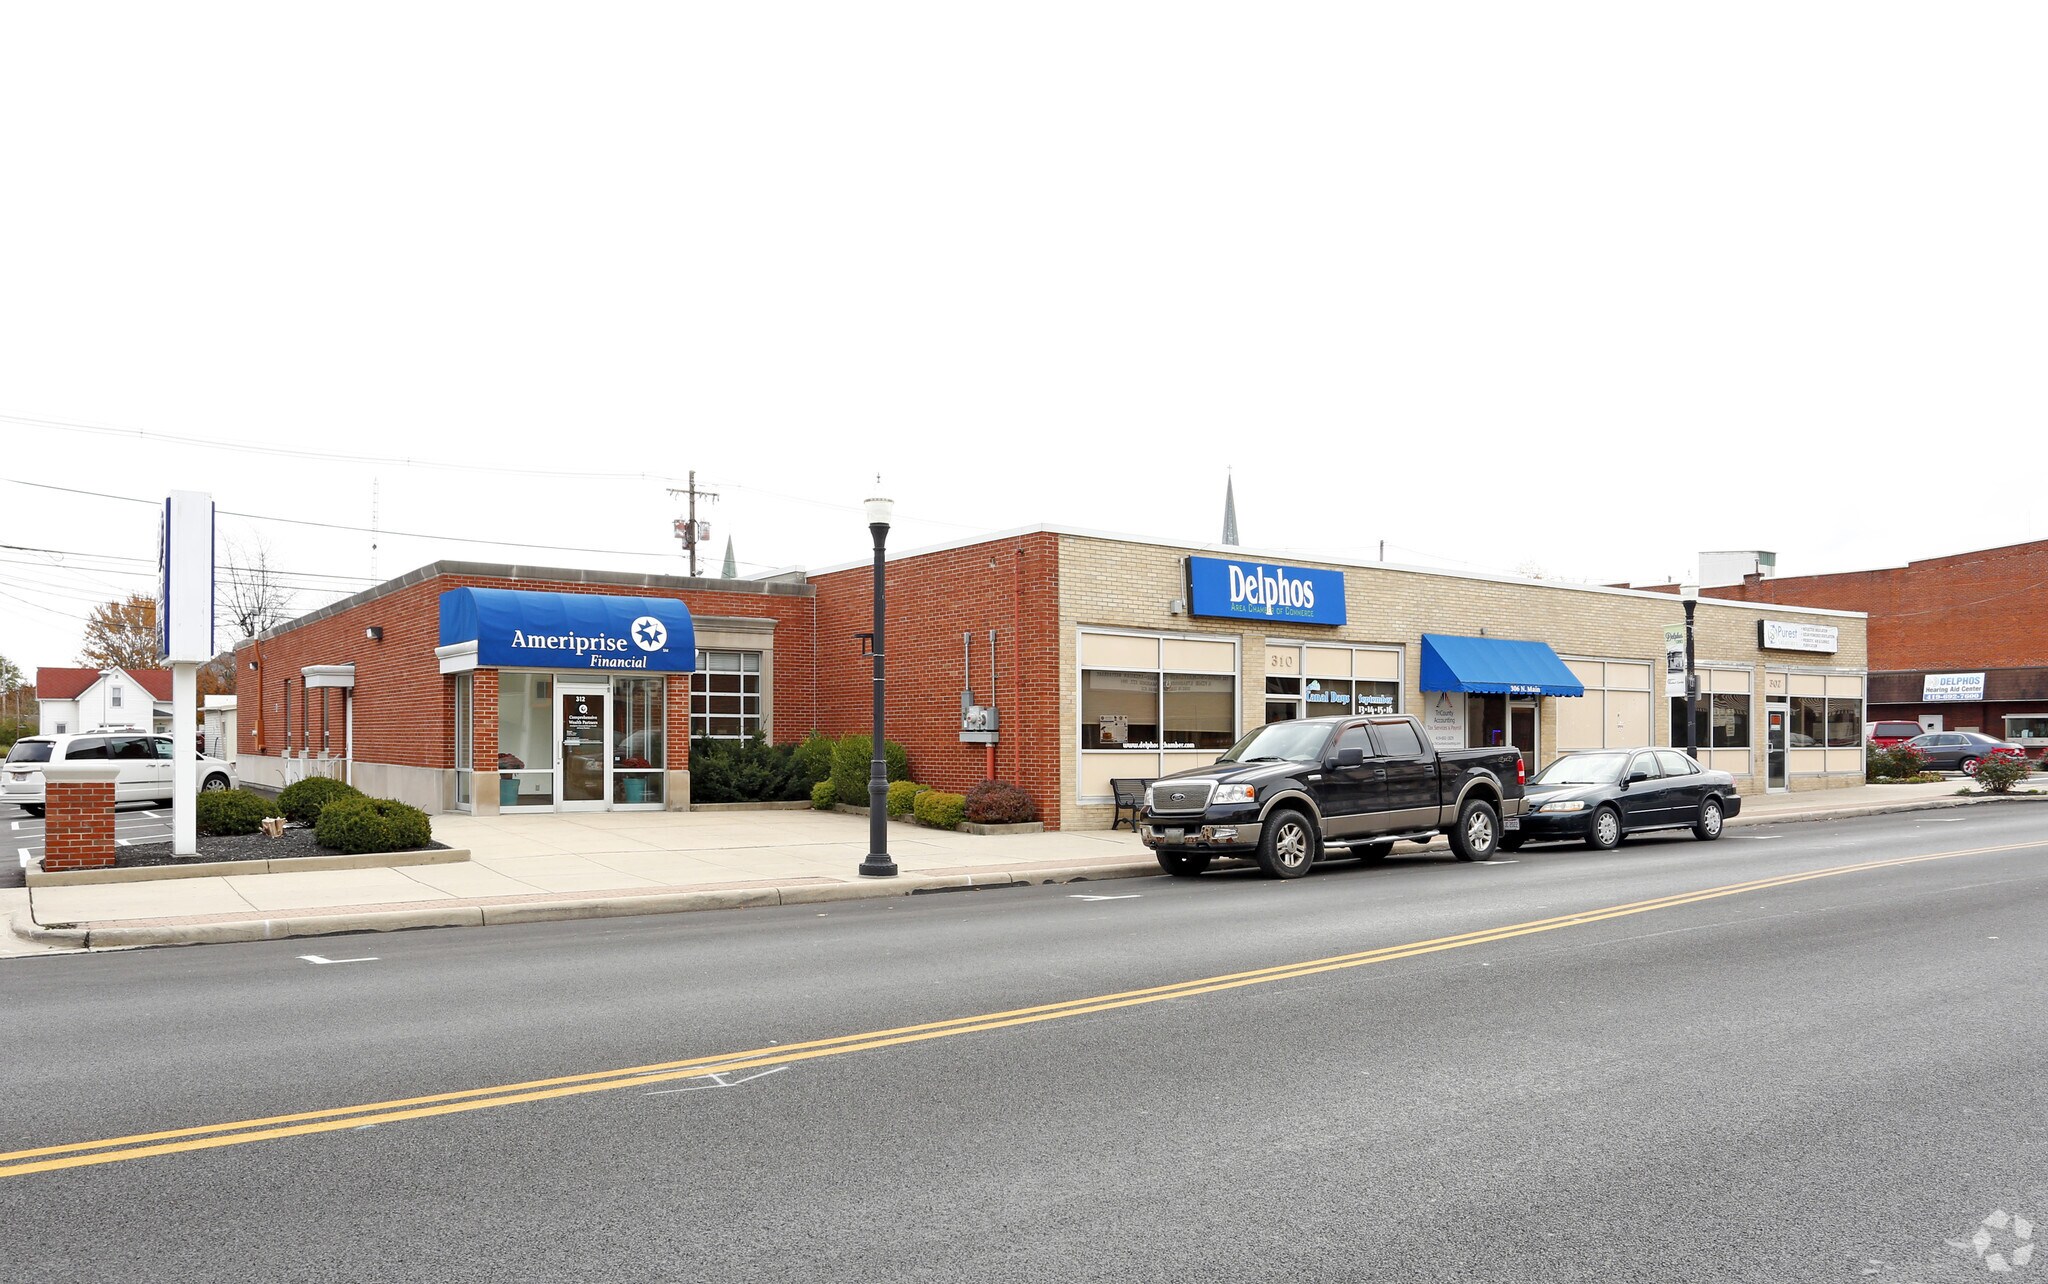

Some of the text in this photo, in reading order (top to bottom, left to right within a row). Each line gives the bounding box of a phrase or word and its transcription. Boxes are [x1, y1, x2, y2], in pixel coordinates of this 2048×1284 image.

[1228, 564, 1315, 615] Delphos
[1777, 626, 1798, 639] Purest
[511, 630, 628, 656] Ameriprise
[590, 654, 647, 669] Financial
[1271, 655, 1293, 667] 310
[1940, 676, 1981, 686] DELPHOS
[1527, 685, 1541, 693] Main
[1358, 693, 1394, 705] September
